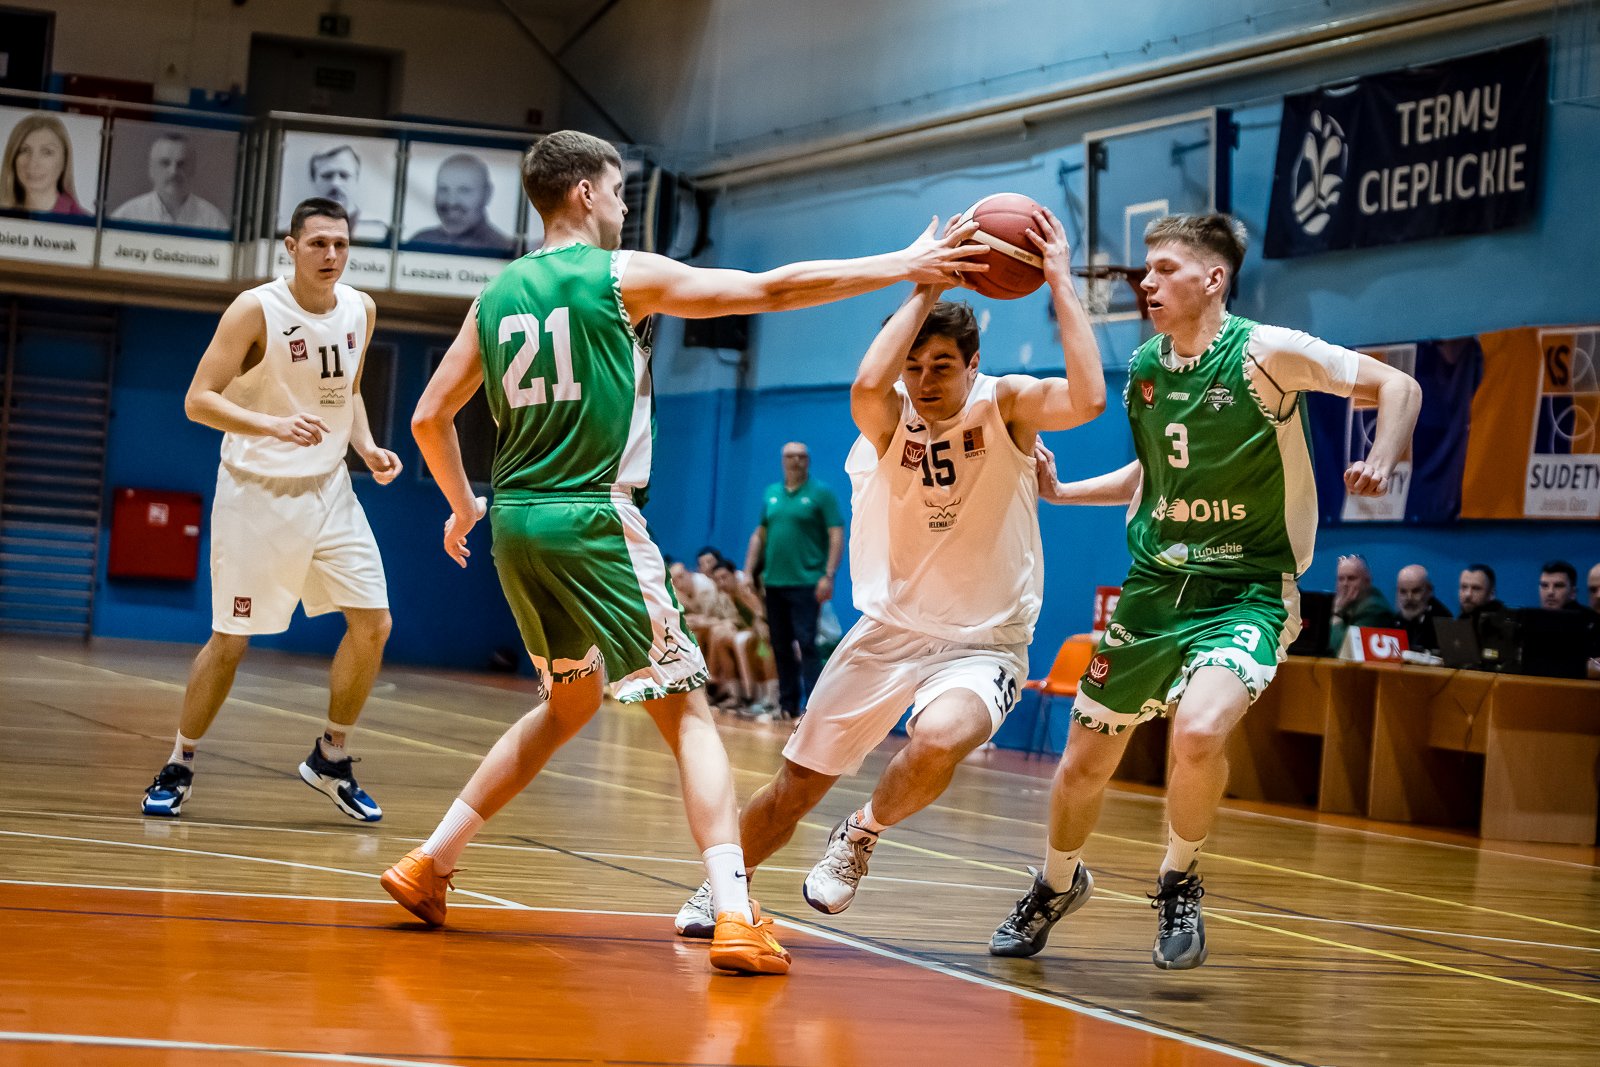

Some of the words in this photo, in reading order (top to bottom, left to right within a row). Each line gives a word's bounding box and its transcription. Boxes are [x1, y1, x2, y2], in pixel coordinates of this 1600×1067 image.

[1396, 83, 1501, 146] TERMY
[1359, 144, 1527, 216] CIEPLICKIE
[33, 234, 77, 251] Nowak
[114, 244, 147, 263] Jerzy
[318, 344, 344, 379] 11
[498, 306, 582, 409] 21
[964, 449, 987, 460] SUDETY
[1165, 422, 1190, 469] 3
[922, 440, 956, 487] 15
[1190, 498, 1247, 522] Oils
[1231, 624, 1262, 652] 3
